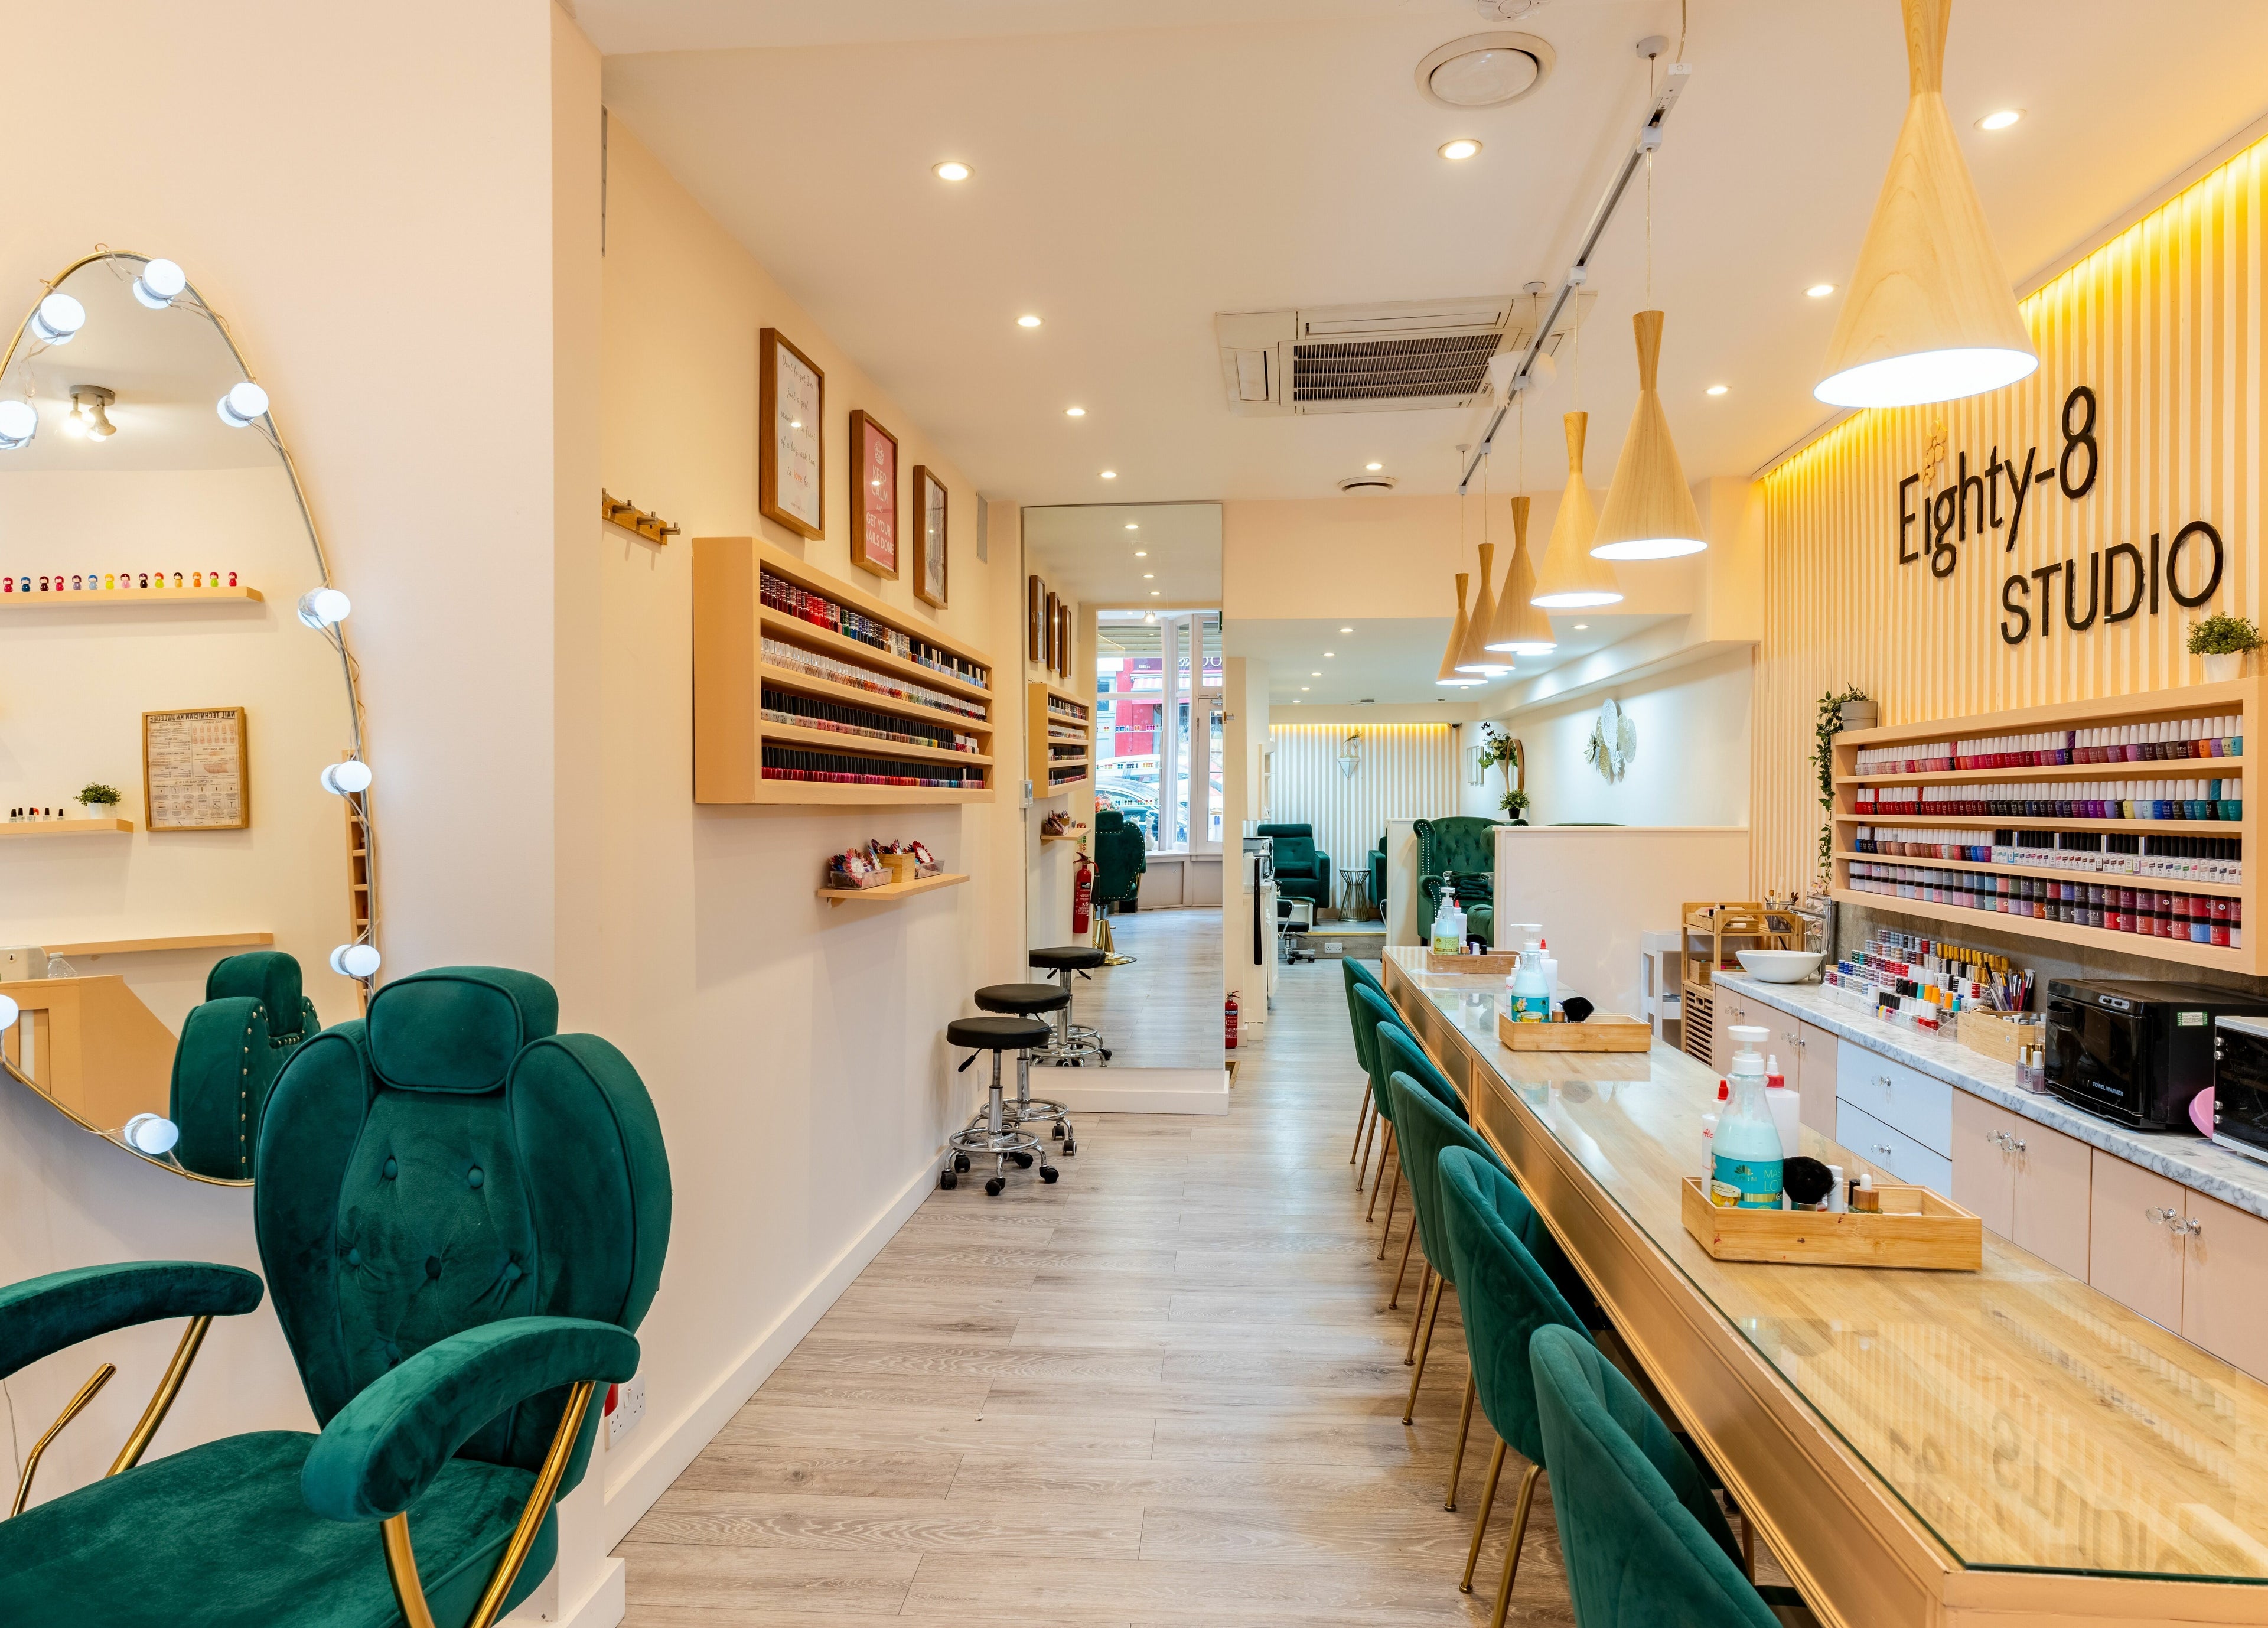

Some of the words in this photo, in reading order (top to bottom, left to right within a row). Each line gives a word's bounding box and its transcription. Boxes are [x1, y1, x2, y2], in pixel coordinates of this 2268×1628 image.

[793, 365, 806, 383] forget
[787, 388, 796, 401] just
[800, 400, 809, 411] girl
[780, 411, 799, 432] stand
[805, 426, 816, 442] front
[781, 436, 786, 449] of
[787, 466, 791, 476] to
[794, 469, 803, 483] love
[872, 464, 887, 486] KEEP
[1899, 385, 2098, 578] Eighty-8
[871, 485, 888, 504] CALM
[866, 512, 876, 526] GET
[877, 518, 891, 538] YOUR
[881, 538, 894, 556] DONE
[2000, 520, 2224, 644] STUDIO
[2093, 1081, 2106, 1090] TOWEL
[2106, 1086, 2124, 1096] WARMER
[1702, 1129, 1713, 1138] Alc
[1764, 1169, 1783, 1178] MAS
